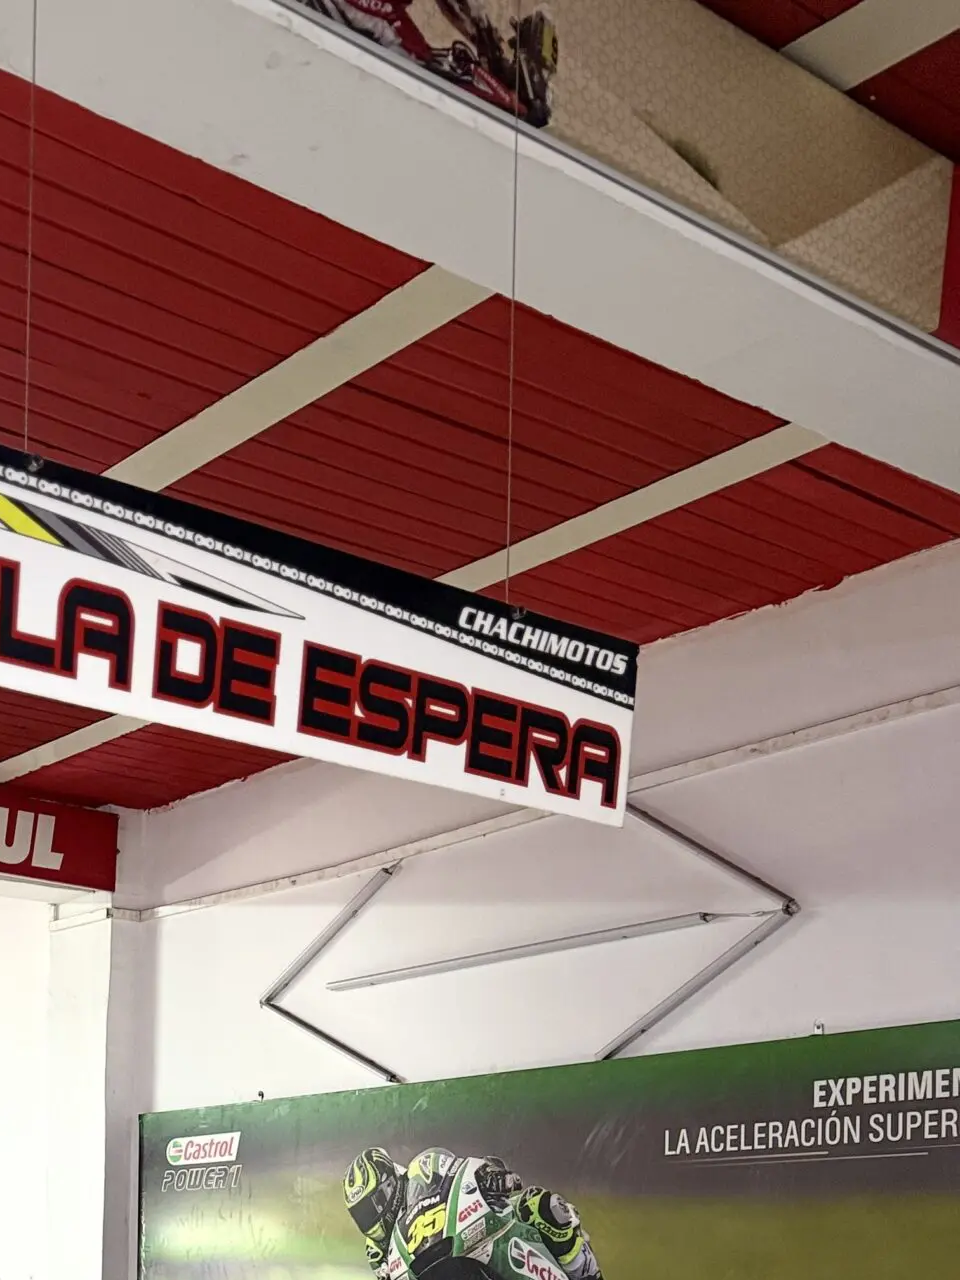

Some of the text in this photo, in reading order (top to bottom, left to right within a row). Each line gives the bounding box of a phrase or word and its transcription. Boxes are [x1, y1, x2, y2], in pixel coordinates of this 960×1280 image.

[458, 605, 629, 675] CHACHIMOTOS
[152, 600, 282, 726] DE
[298, 640, 622, 809] ESPERA
[183, 1136, 235, 1161] Castrol
[664, 1128, 690, 1156] LA
[695, 1110, 861, 1154] ACELERACIÓN
